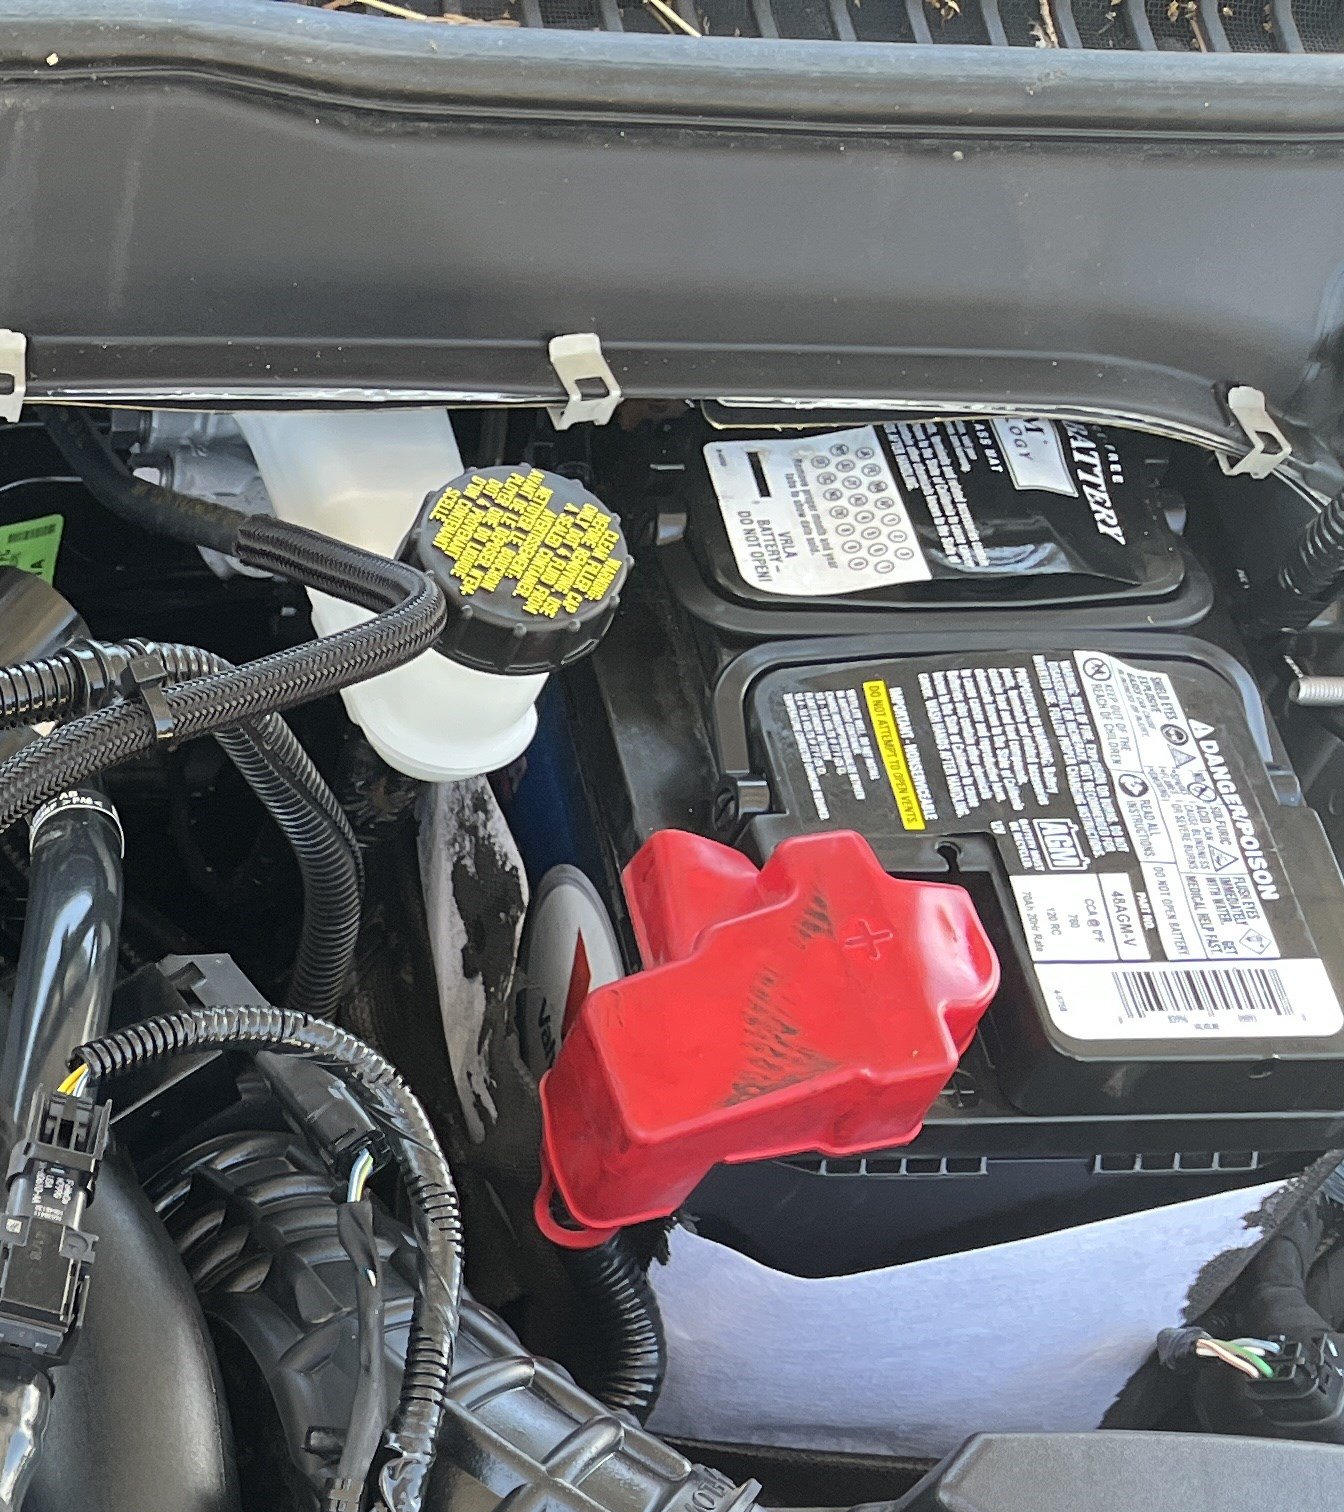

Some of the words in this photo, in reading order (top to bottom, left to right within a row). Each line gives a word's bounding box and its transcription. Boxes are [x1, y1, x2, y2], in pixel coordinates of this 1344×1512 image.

[481, 480, 505, 499] DOT
[495, 475, 526, 507] PLOYER
[516, 472, 542, 499] AVANT
[479, 500, 490, 510] 4
[508, 495, 529, 517] DE
[514, 486, 551, 532] NETTOYER
[562, 501, 581, 516] A
[436, 499, 473, 551] CONTENANT
[480, 508, 506, 529] QUE
[499, 513, 521, 528] LE
[573, 506, 599, 530] ONLY
[738, 511, 754, 525] DO
[443, 507, 488, 560] PROVENANT
[472, 524, 493, 544] DU
[508, 530, 527, 547] LE
[541, 515, 577, 549] SEALED
[561, 526, 586, 550] DOT
[578, 512, 609, 549] BEFORE
[744, 528, 761, 547] NOT
[757, 520, 782, 562] BATTERY
[557, 545, 574, 561] 4
[590, 528, 618, 563] CLEAN
[778, 532, 797, 558] VRLA
[454, 540, 485, 581] LIQUIDE
[477, 545, 519, 590] BOUCHON
[538, 555, 569, 587] FLUID
[517, 548, 554, 598] CONTAINER.
[571, 558, 603, 592] FILLER
[585, 558, 620, 599] WARNING:
[525, 583, 551, 613] FROM
[537, 594, 564, 616] USE
[559, 589, 582, 612] CAP
[869, 686, 881, 697] DO
[873, 700, 886, 716] NOT
[889, 687, 914, 738] IMPORTANT
[1110, 705, 1123, 720] OUT
[878, 720, 897, 757] ATTEMPT
[890, 760, 900, 770] TO
[893, 773, 907, 793] OPEN
[1141, 800, 1155, 820] READ
[1199, 740, 1279, 899] DANGER/POISON
[1147, 823, 1160, 836] ALL
[1175, 816, 1191, 841] SEVERE
[1208, 807, 1231, 845] SULFURIC
[1037, 819, 1079, 866] AGM
[1153, 867, 1165, 877] DO
[1158, 881, 1170, 895] NOT
[1085, 899, 1097, 915] CCA
[1136, 892, 1150, 913] PART
[1162, 899, 1176, 919] OPEN
[1186, 876, 1205, 910] MEDICAL
[1197, 914, 1214, 931] HELP
[1243, 902, 1259, 919] EYES
[1047, 908, 1058, 921] 120
[1112, 891, 1136, 946] 48AGM-V
[1051, 924, 1061, 935] RC
[1169, 923, 1189, 954] BATTERY
[1034, 934, 1043, 951] Rate
